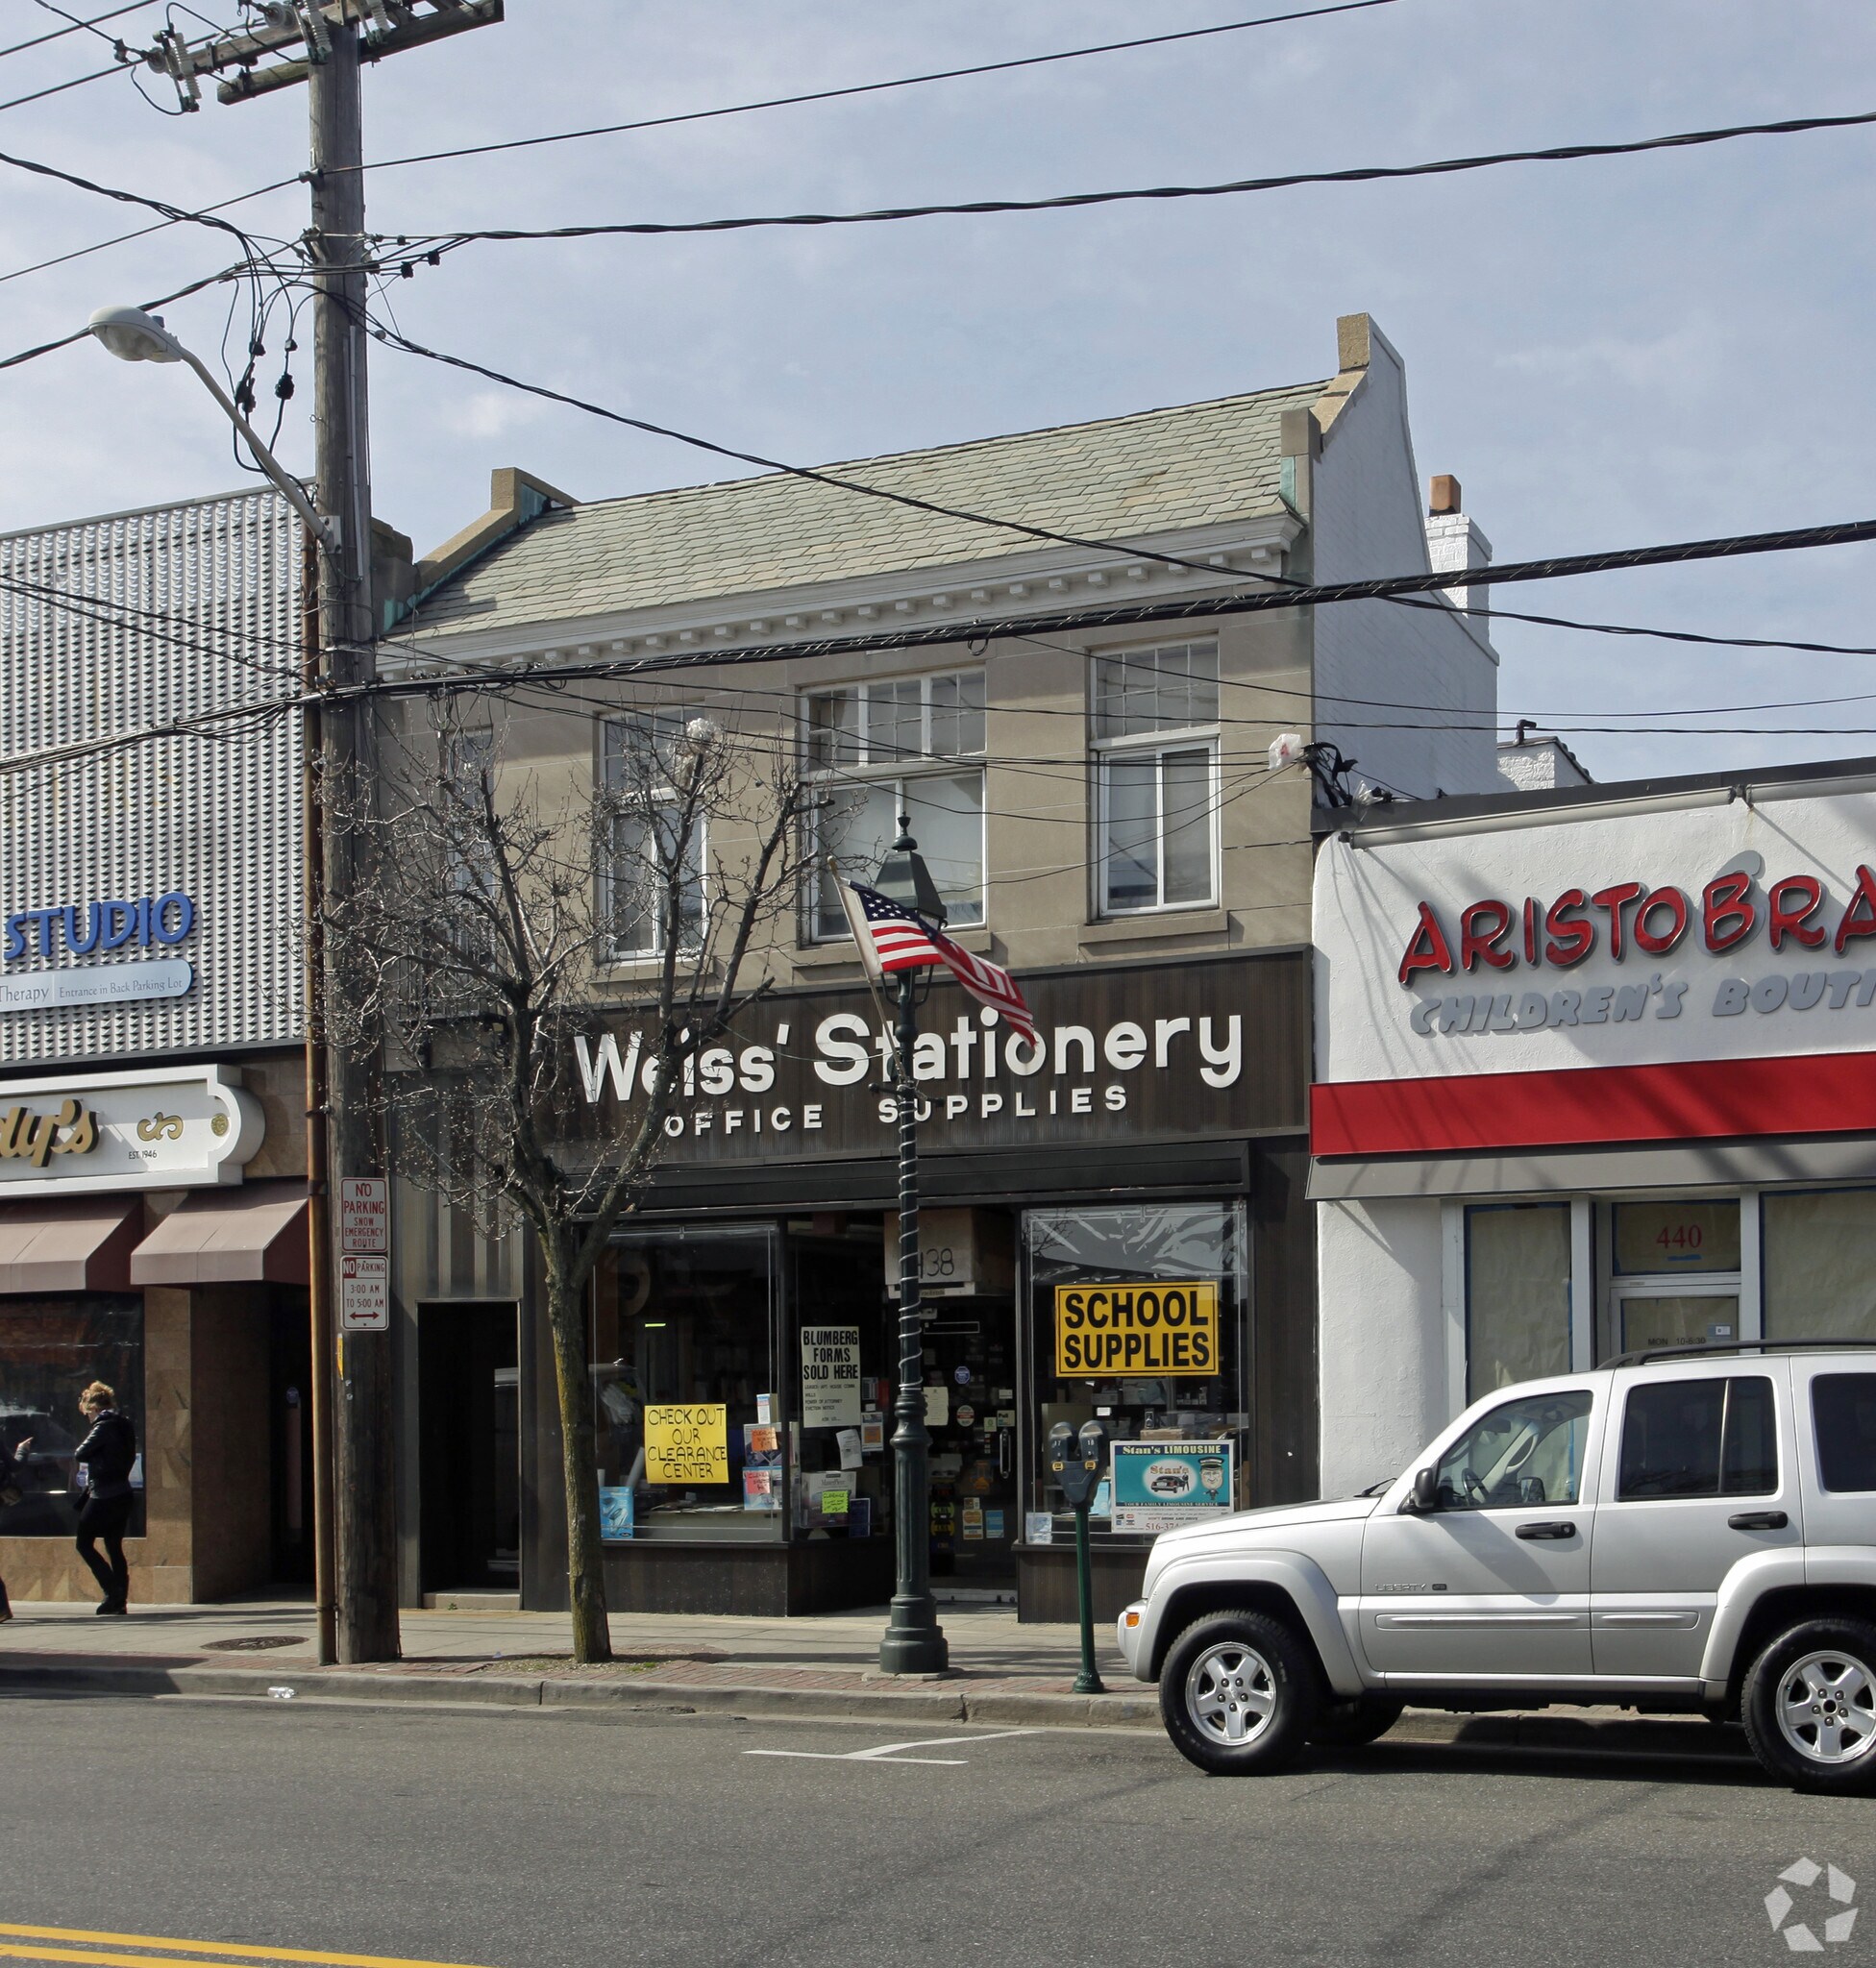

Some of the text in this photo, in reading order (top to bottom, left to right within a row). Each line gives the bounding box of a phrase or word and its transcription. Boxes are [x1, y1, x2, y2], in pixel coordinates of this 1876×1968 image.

[4, 892, 193, 960] STUDIO
[60, 987, 97, 998] Entrance
[100, 986, 108, 995] in
[110, 981, 130, 994] Back
[133, 978, 164, 992] Parking
[167, 976, 183, 989] Lot
[1410, 972, 1689, 1035] CHILDREN'S
[813, 1005, 1242, 1089] Stationery
[664, 1085, 1127, 1138] OFFICE SUPPLIES
[142, 1149, 158, 1159] 1946
[356, 1183, 372, 1197] NO
[344, 1200, 384, 1215] PARKING
[354, 1217, 375, 1227] SNOW
[345, 1227, 383, 1237] EMERGENCY
[1657, 1224, 1702, 1248] 440
[352, 1238, 377, 1248] ROUTE
[343, 1260, 384, 1274] NO PARKING
[350, 1284, 381, 1294] 3:00 AM
[346, 1298, 384, 1309] TO 5:00 AM
[1064, 1291, 1209, 1329] SCHOOL
[803, 1330, 858, 1346] BLUMBERG
[813, 1347, 851, 1363] FORMS
[1064, 1332, 1210, 1368] SUPPLIES
[803, 1365, 858, 1380] SOLD HERE
[648, 1408, 725, 1426] CHECK OUT
[672, 1428, 701, 1444] OUR
[648, 1446, 727, 1462] CLEARANCE
[1123, 1444, 1222, 1455] Stan's LIMOUSINE
[663, 1463, 714, 1478] CENTER
[1375, 1583, 1425, 1591] LIBERTY
